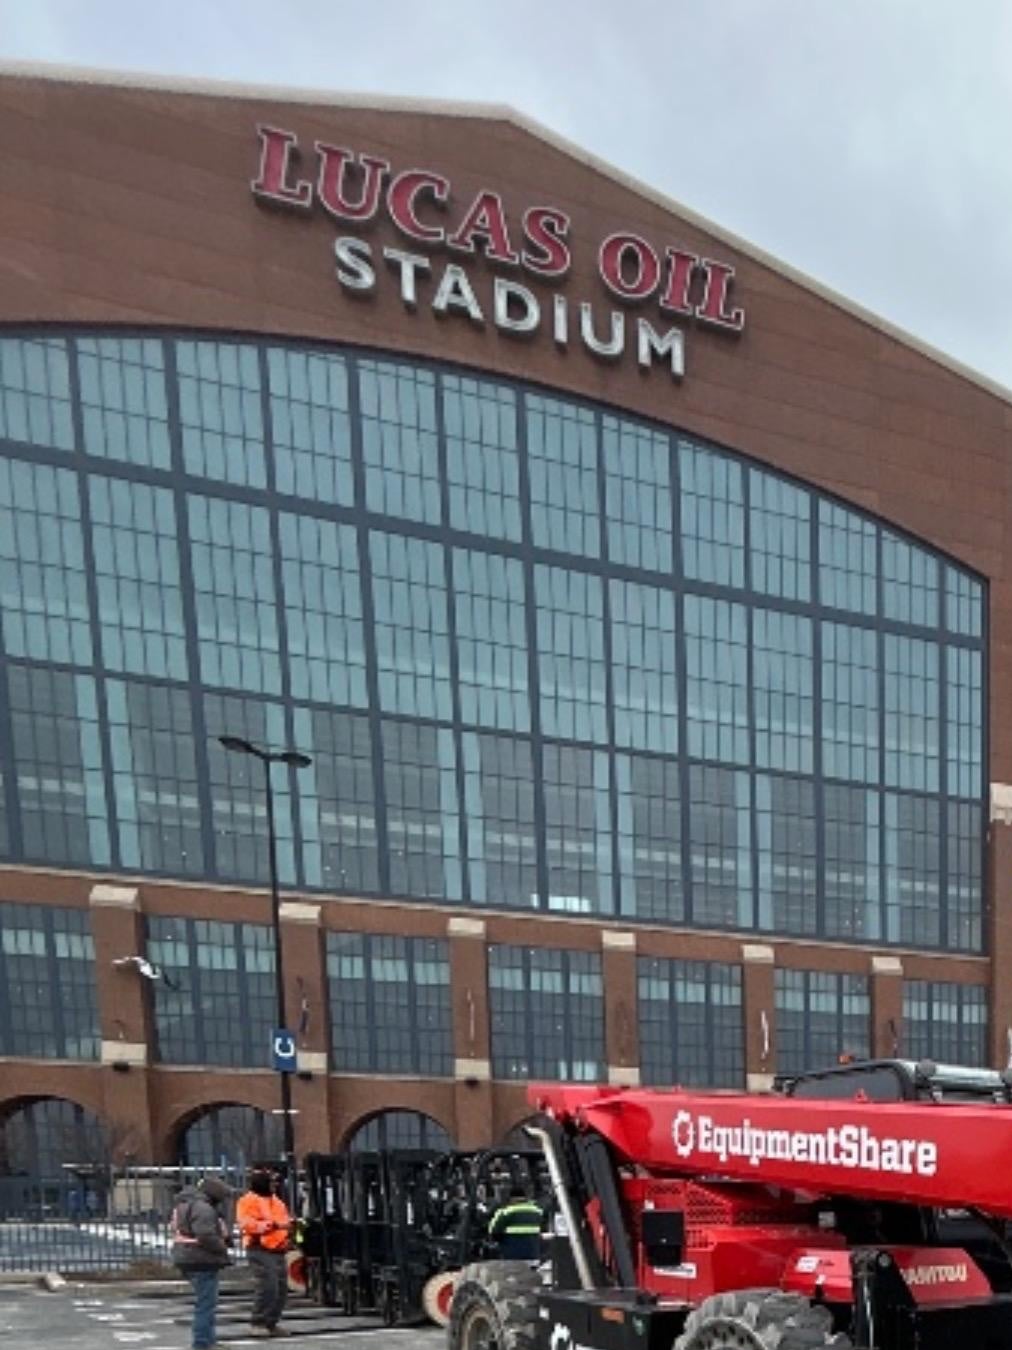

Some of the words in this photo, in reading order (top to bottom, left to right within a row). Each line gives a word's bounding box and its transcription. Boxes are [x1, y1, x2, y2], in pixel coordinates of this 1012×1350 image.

[251, 124, 571, 276] LUCAS
[600, 233, 744, 330] OIL
[334, 236, 685, 376] STADIUM
[698, 1116, 938, 1177] EquipmentShare
